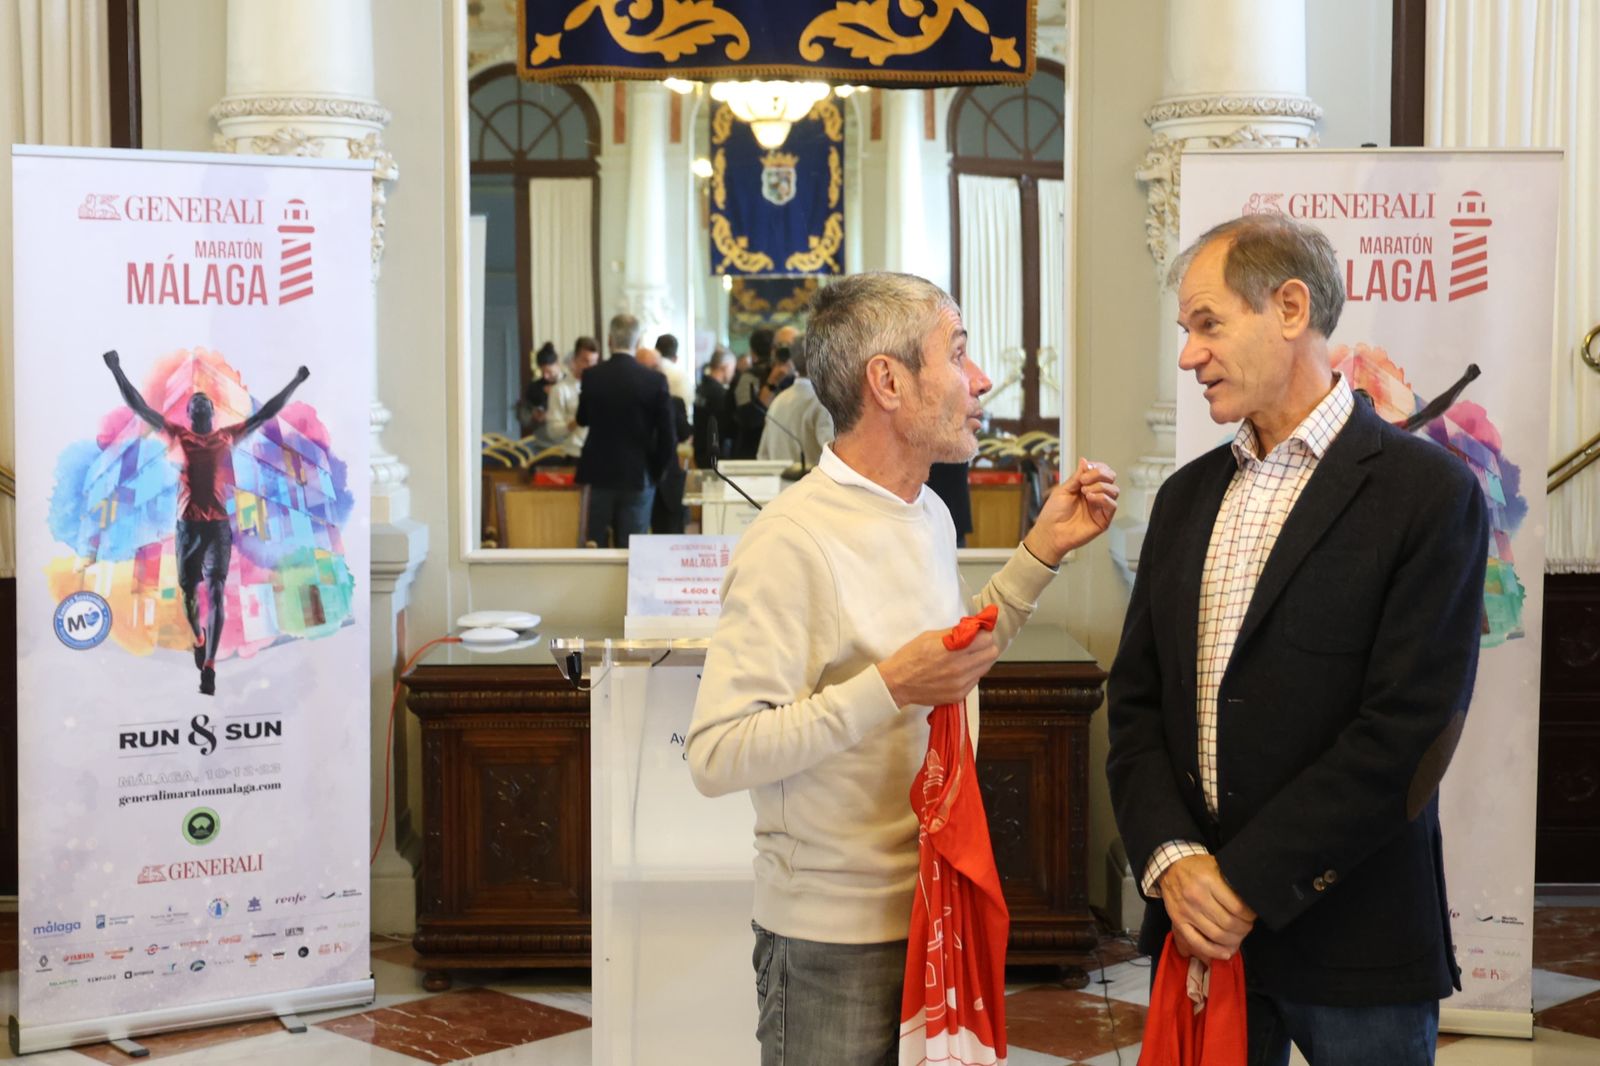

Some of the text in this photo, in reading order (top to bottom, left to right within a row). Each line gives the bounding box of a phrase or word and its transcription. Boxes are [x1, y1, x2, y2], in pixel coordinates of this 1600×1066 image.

[124, 195, 265, 225] GENERALI
[1288, 193, 1436, 219] GENERALI
[194, 239, 263, 259] MARATÓN
[1359, 233, 1433, 254] MARATÓN
[127, 254, 268, 305] MÁLAGA
[1346, 259, 1437, 302] LAGA
[119, 714, 282, 756] RUN & SUN
[118, 781, 281, 806] generalimaratonmalaga.com
[168, 853, 263, 881] GENERALI
